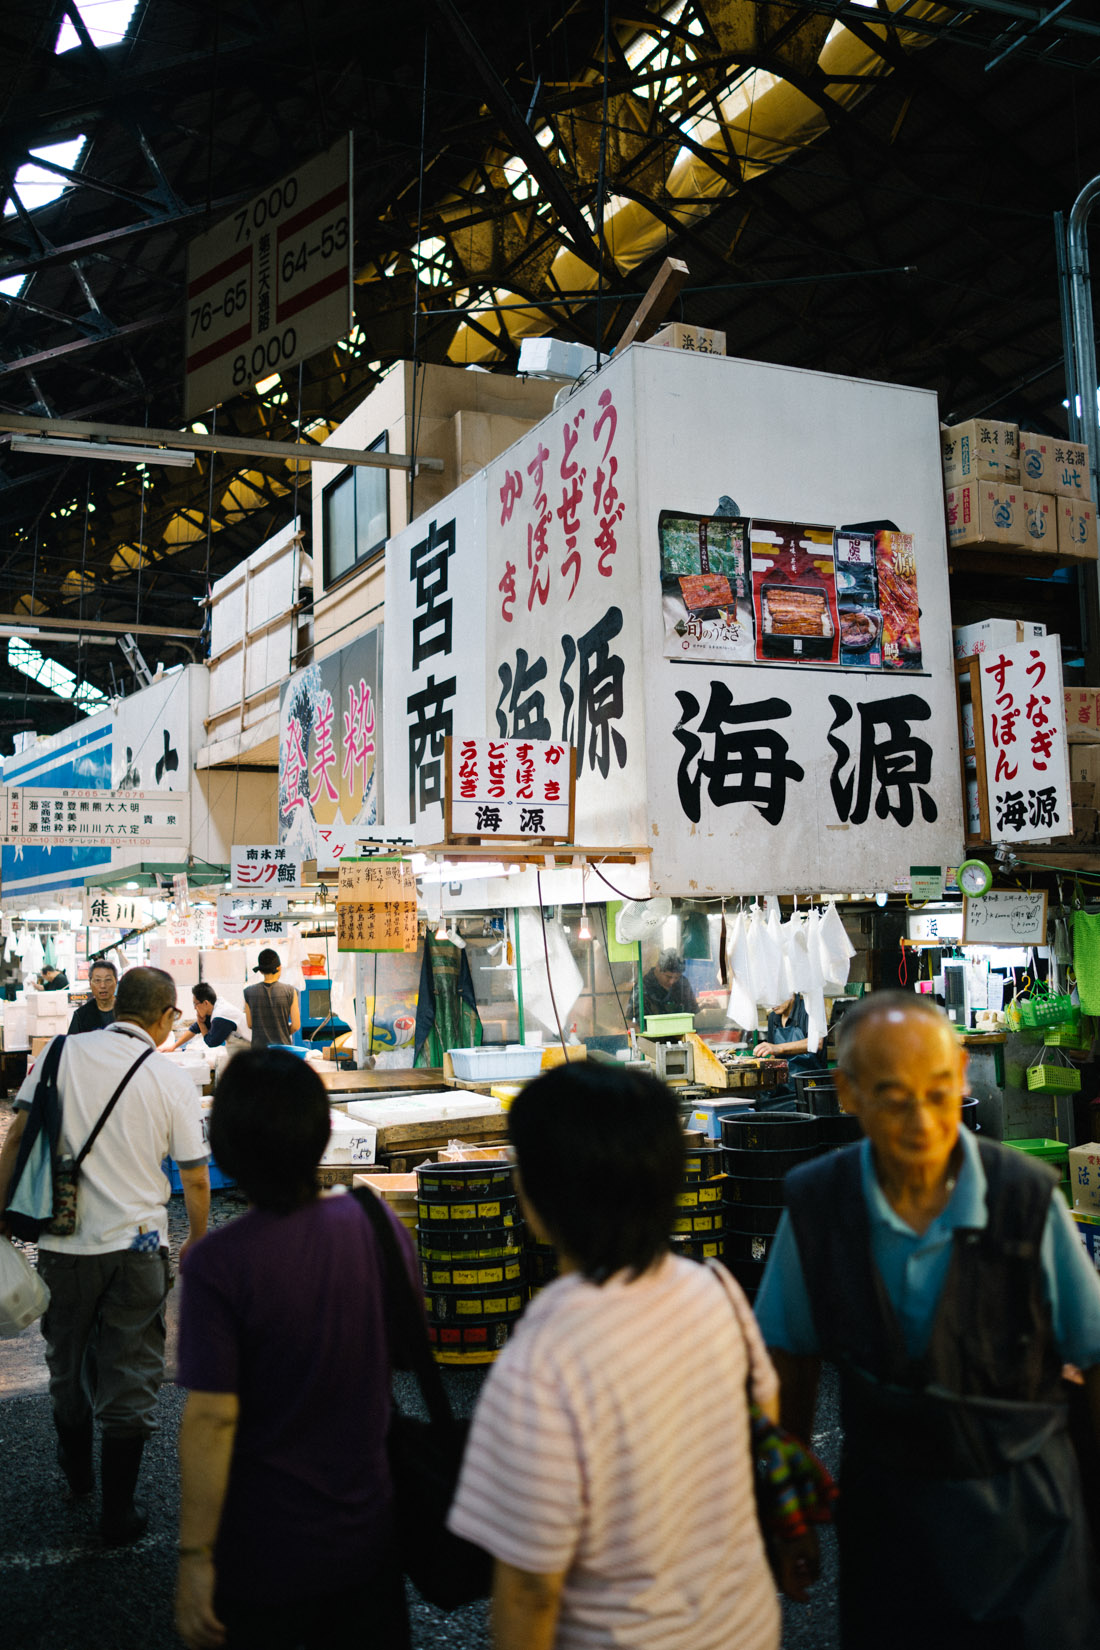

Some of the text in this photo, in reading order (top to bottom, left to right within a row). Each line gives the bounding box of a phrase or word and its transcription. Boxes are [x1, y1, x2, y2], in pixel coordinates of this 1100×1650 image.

[233, 177, 298, 243] 7,000
[281, 217, 348, 282] 64-53
[190, 279, 247, 339] 76-65
[232, 328, 297, 386] 8,000
[682, 334, 722, 356] 浜名
[1055, 448, 1086, 466] 浜名湖
[1061, 468, 1083, 488] 山七
[557, 408, 587, 602] どぜう
[593, 388, 625, 577] うなぎ
[498, 470, 523, 622] かき
[527, 442, 551, 613] すっぽん
[685, 614, 741, 641] 旬のうなぎ
[406, 517, 457, 825] 宮商
[496, 606, 627, 780] 海源
[985, 654, 1020, 783] すっぽん
[1025, 650, 1058, 771] うなぎ
[281, 680, 375, 814] 登美粋
[459, 741, 479, 798] うなぎ
[487, 742, 509, 798] どぜう
[672, 681, 938, 827] 海源
[516, 743, 536, 799] すっぽん
[544, 745, 565, 801] かき
[11, 792, 19, 833] 第五十一棟
[28, 800, 39, 833] 海源
[41, 800, 51, 833] 宮商築地
[54, 801, 64, 833] 登美粋
[67, 801, 77, 833] 登美粋
[80, 802, 90, 833] 熊川
[92, 802, 102, 833] 熊川
[105, 802, 115, 834] 大六
[117, 802, 127, 834] 大六
[130, 803, 140, 835] 明定
[143, 815, 177, 825] 貴泉
[475, 805, 546, 833] 海源
[996, 786, 1060, 832] 海源
[237, 863, 296, 883] ミンク鯨
[89, 899, 135, 923] 熊川
